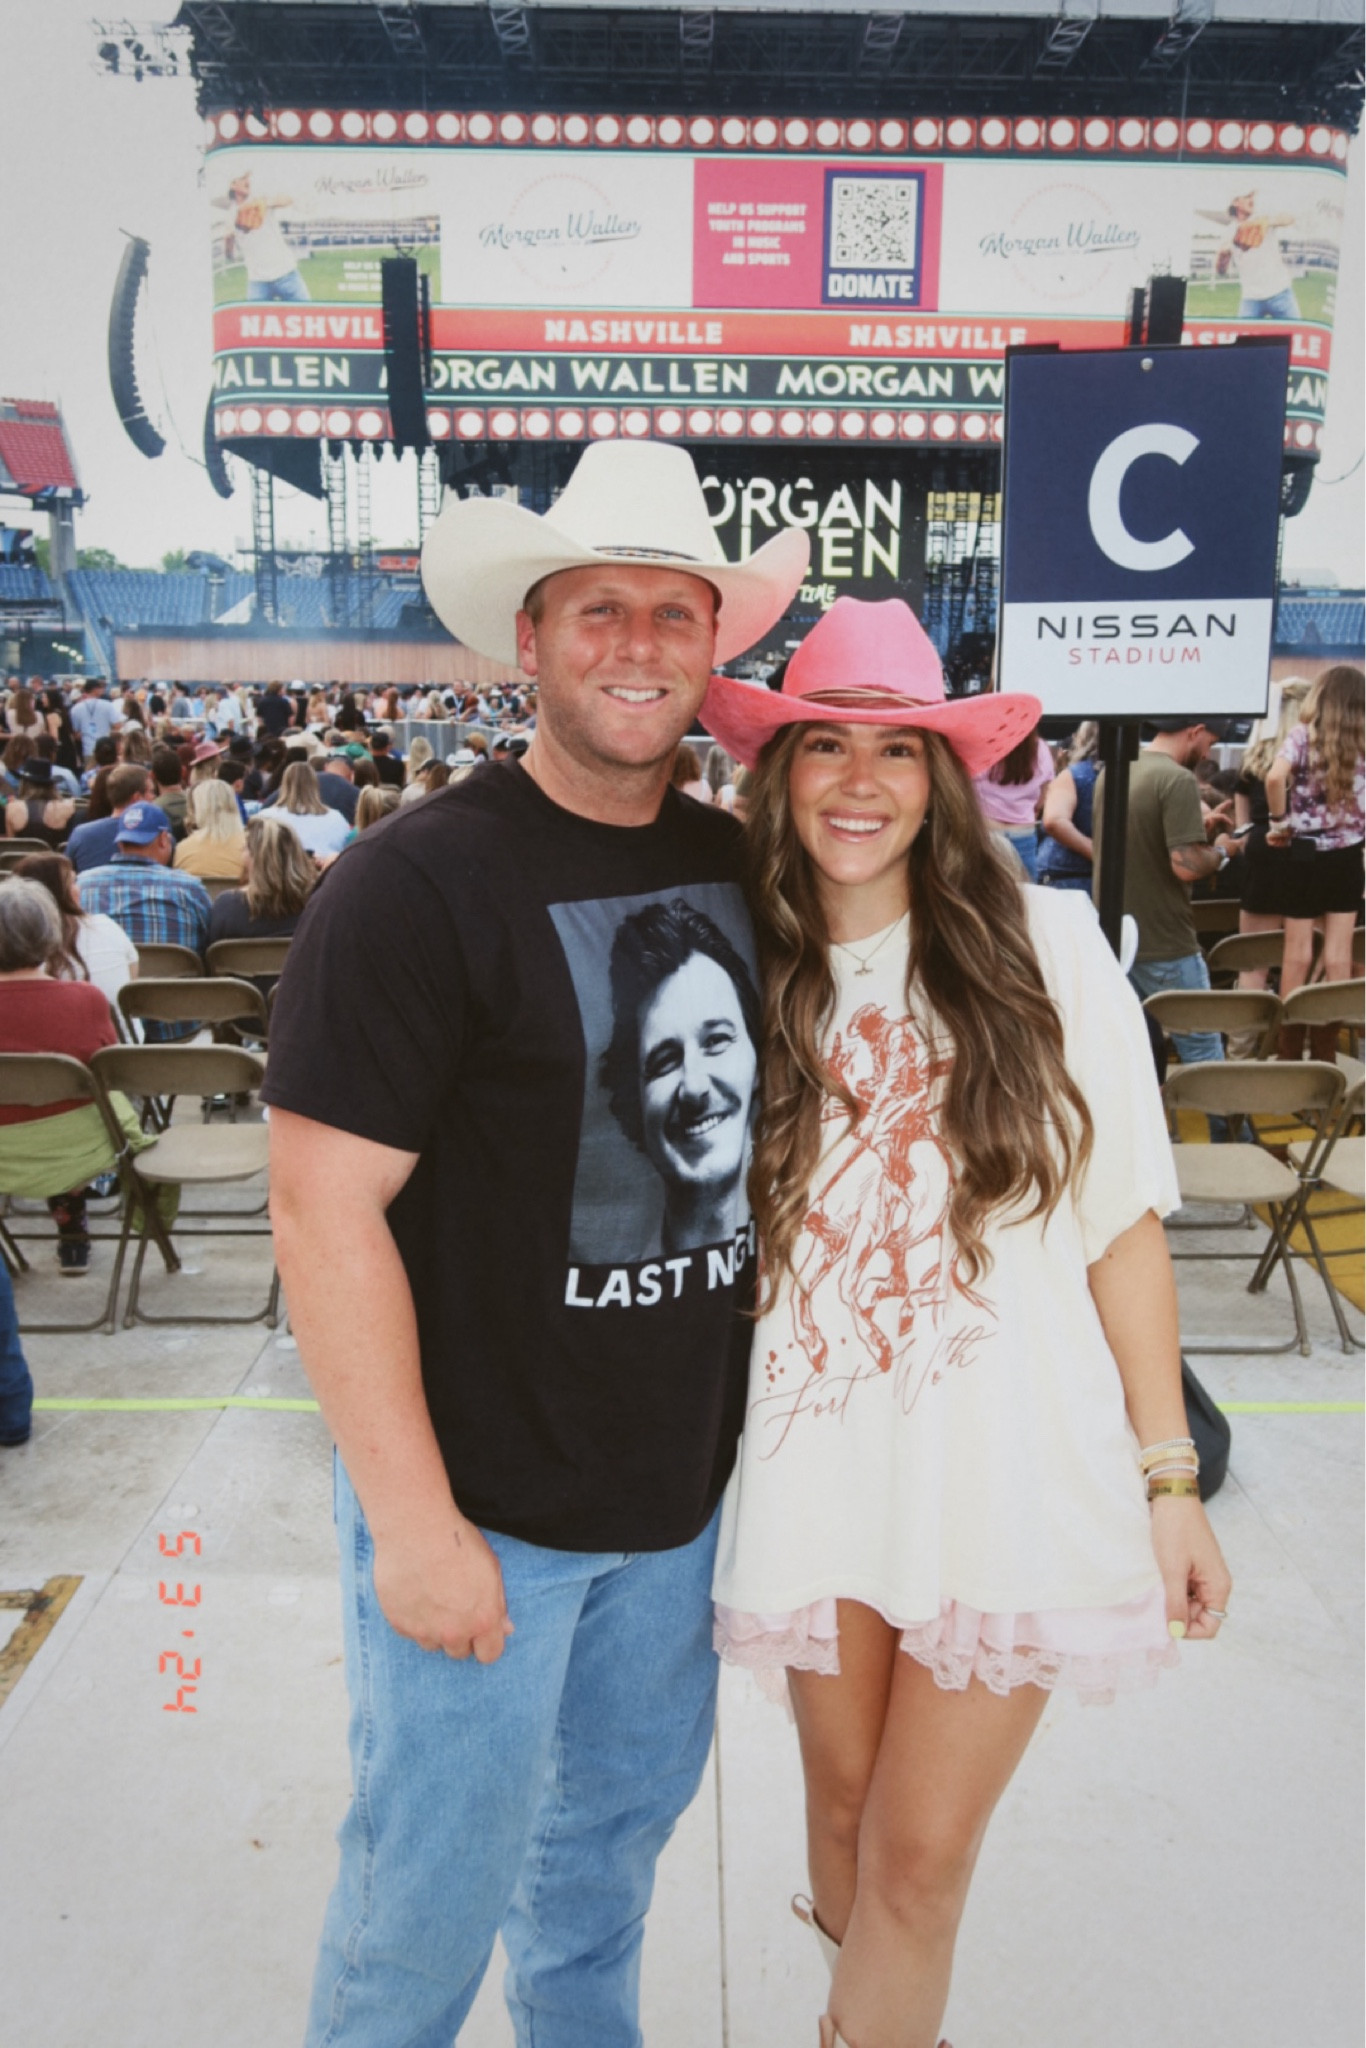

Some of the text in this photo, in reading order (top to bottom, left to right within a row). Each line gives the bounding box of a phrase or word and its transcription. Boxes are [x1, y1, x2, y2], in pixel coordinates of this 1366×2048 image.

[479, 210, 642, 250] Morgan Wallen
[979, 220, 1141, 259] Morgan Wallen
[828, 273, 914, 299] DONATE
[240, 315, 380, 339] NASHVIL
[545, 319, 722, 344] NASHVILLE
[570, 360, 747, 393] WALLEN
[776, 363, 953, 397] MORGAN
[701, 475, 902, 528] ORGAN
[1088, 423, 1200, 571] C
[1038, 614, 1236, 640] NISSAN
[1069, 647, 1201, 665] STADIUM
[565, 1256, 692, 1307] LAST
